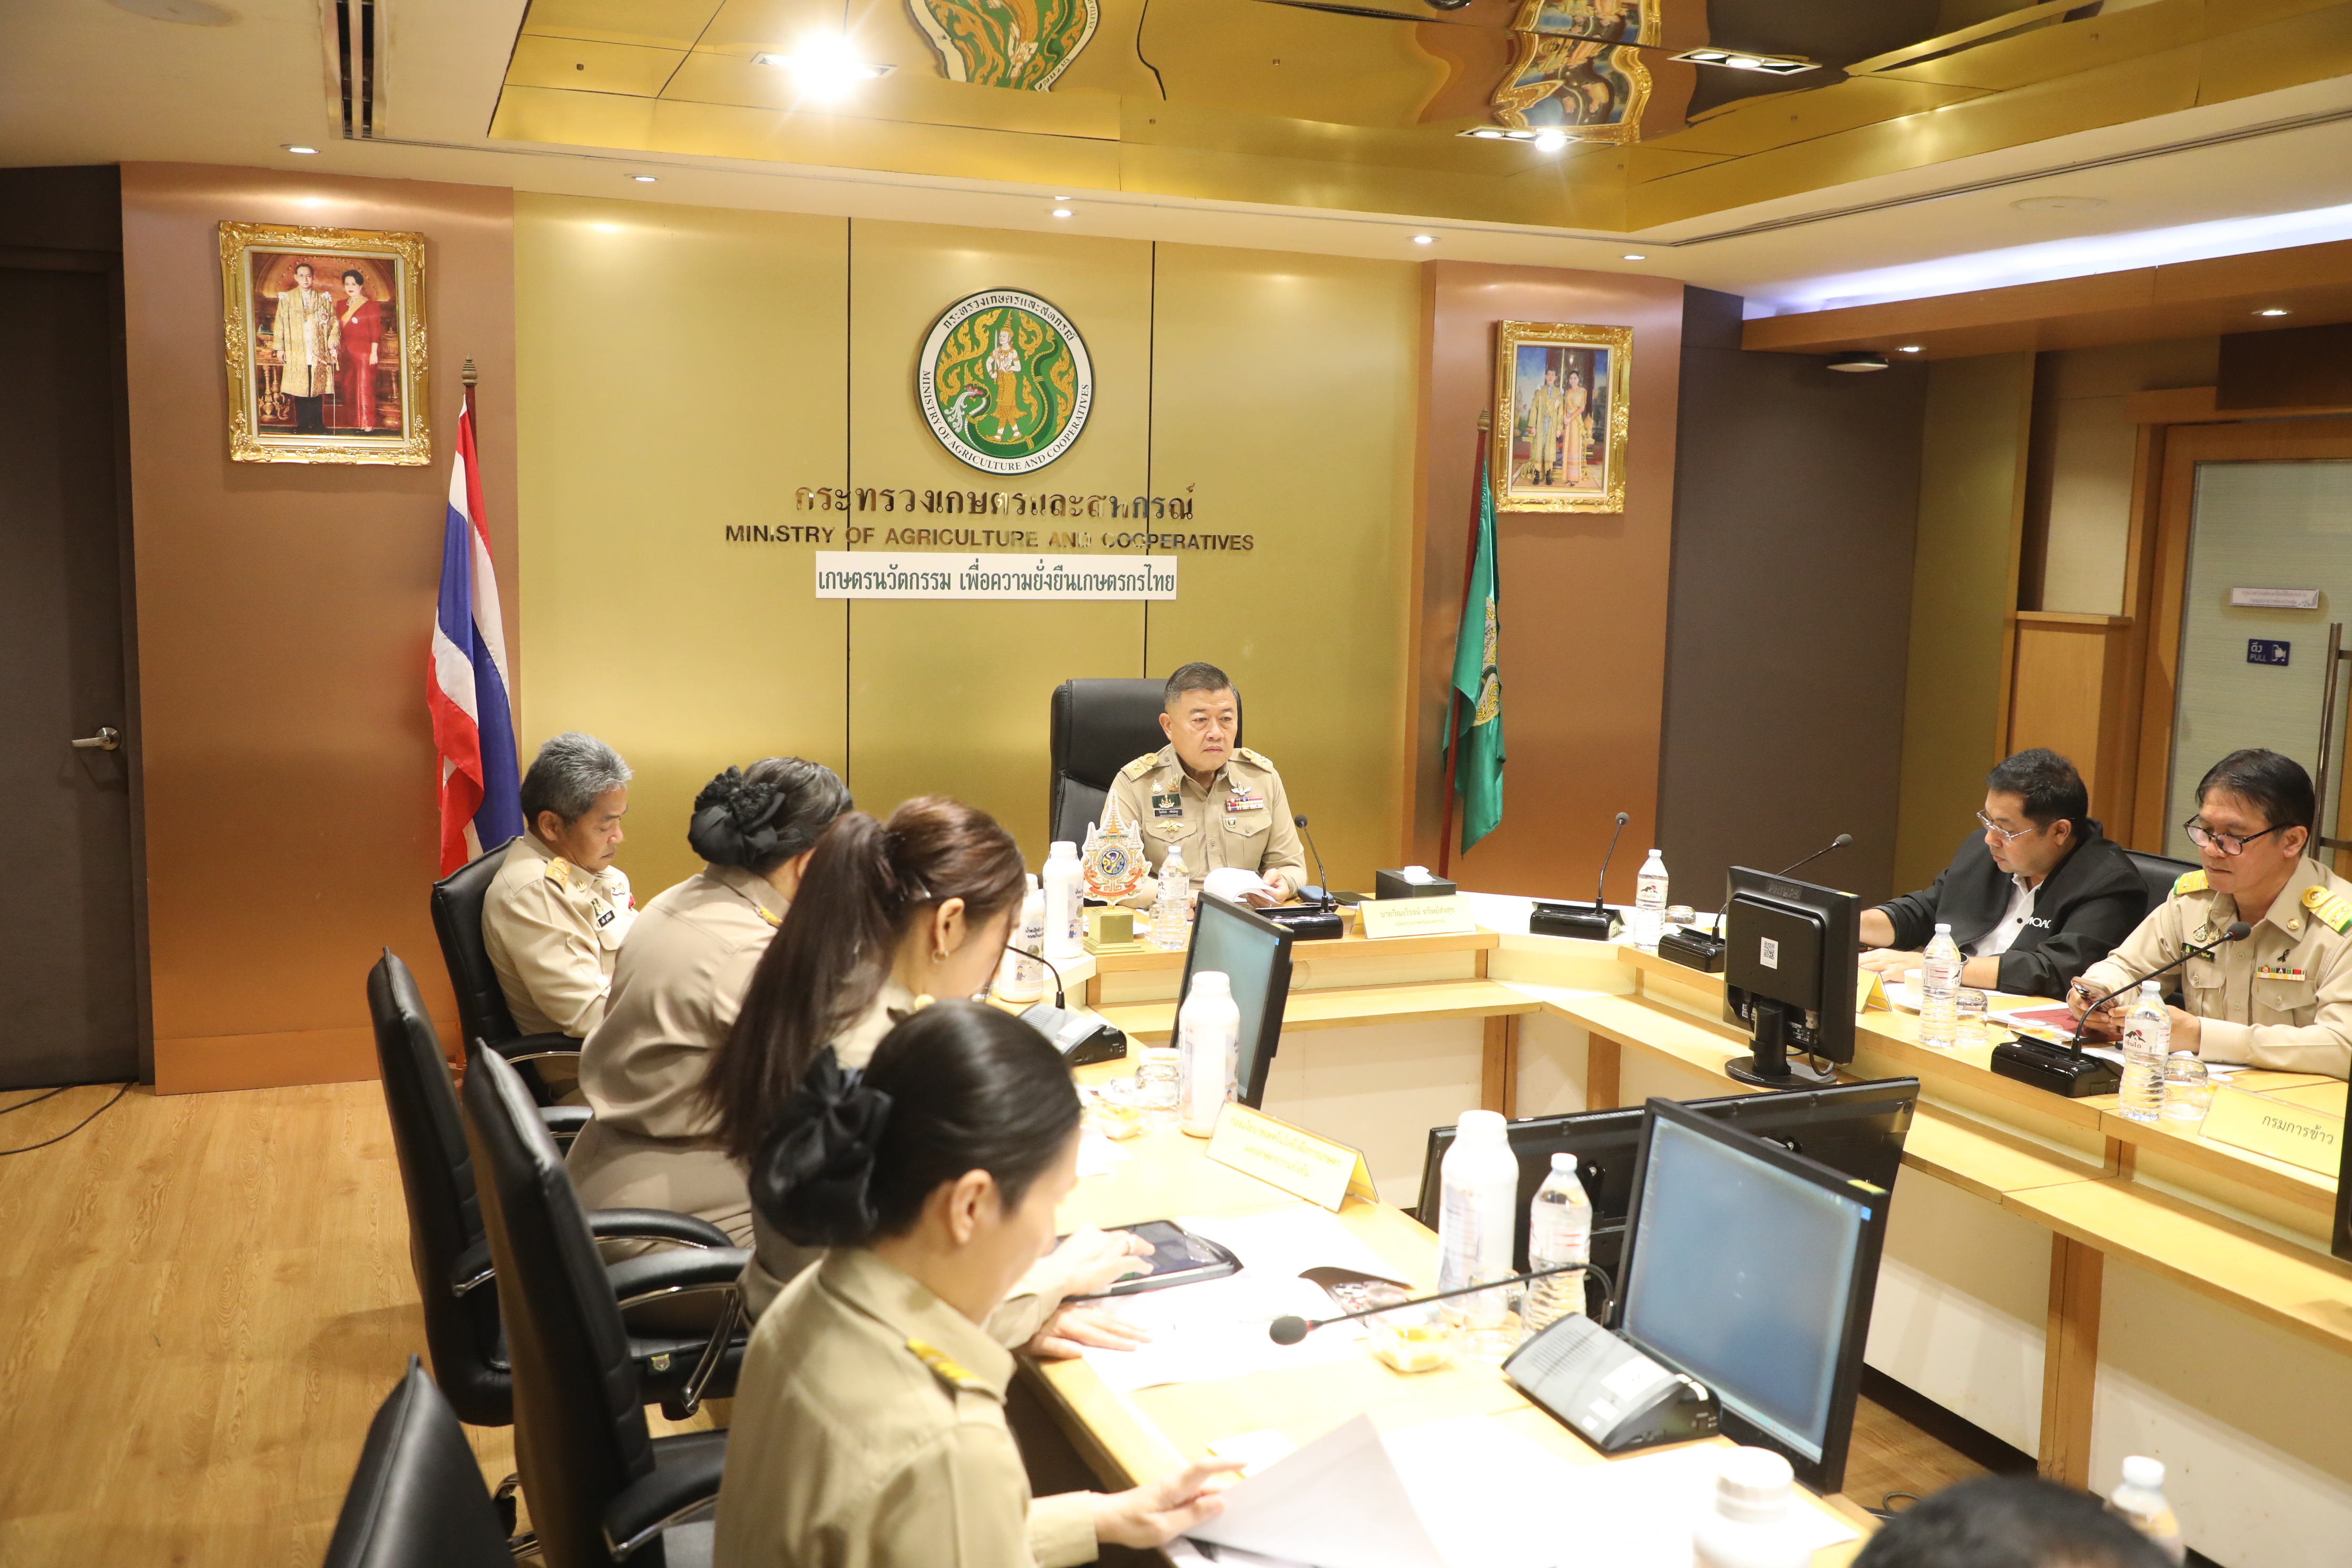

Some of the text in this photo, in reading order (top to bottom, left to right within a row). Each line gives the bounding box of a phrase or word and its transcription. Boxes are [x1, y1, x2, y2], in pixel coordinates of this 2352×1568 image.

[943, 294, 1079, 342] กระทรวงเกษตรและสหกรณ์
[923, 370, 1090, 471] MINISTRY OF AGRICULTURE AND COOPERATIVES
[795, 482, 1195, 520] กระทรวงเกษตรและสหกรณ์
[726, 525, 1254, 551] MINISTRY OF AGRICULTURE AND COOPERATIVES
[818, 558, 1175, 591] เกษตรนวัตกรรม เพื่อความยั่งยืนเกษตรกรไทย
[2250, 653, 2267, 662] PULL
[2251, 641, 2263, 653] ดึง
[2262, 1115, 2334, 1144] กรมการข้าว
